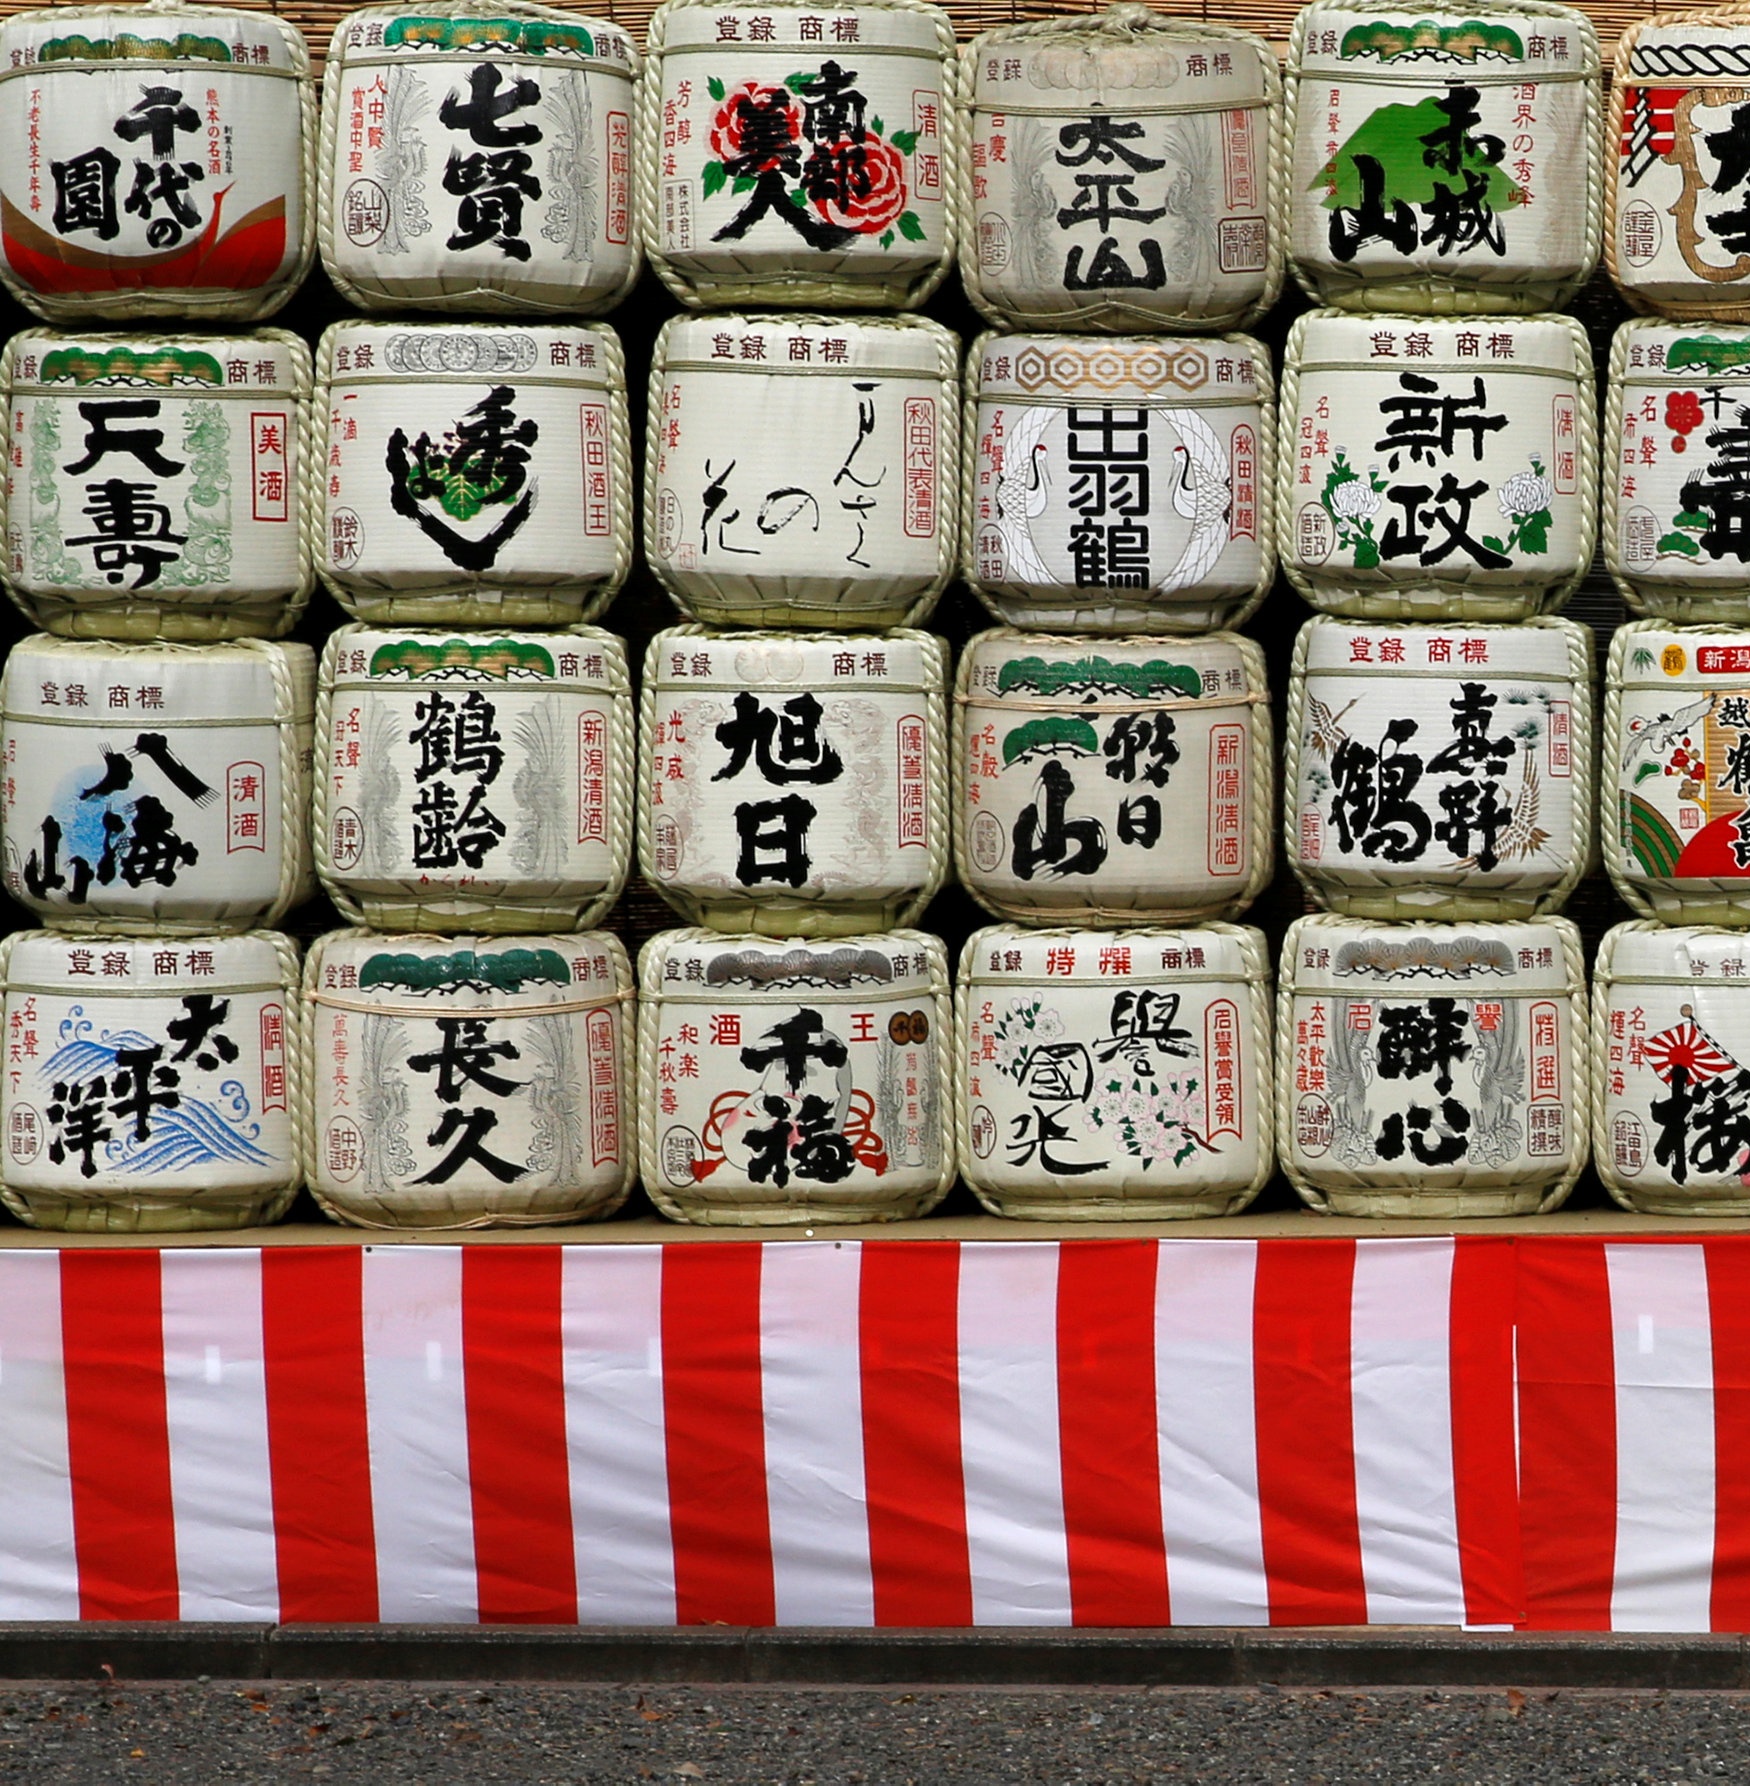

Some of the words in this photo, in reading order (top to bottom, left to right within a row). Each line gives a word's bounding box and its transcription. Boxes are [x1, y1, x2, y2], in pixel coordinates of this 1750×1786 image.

[232, 43, 270, 64] 商標
[716, 15, 776, 42] 登録
[798, 16, 861, 42] 商標
[987, 59, 1022, 81] 登録
[1186, 54, 1233, 77] 商標
[1528, 36, 1568, 60] 商標
[114, 83, 204, 249] 千代の
[206, 88, 221, 175] 熊本の名酒
[439, 62, 543, 262] 七賢
[710, 88, 862, 251] 美人
[799, 60, 871, 214] 南部
[918, 104, 939, 188] 清酒
[48, 147, 120, 240] 園
[1055, 102, 1167, 291] 太平山
[1329, 154, 1418, 262] 山
[227, 359, 276, 384] 商標
[550, 341, 596, 368] 商標
[712, 333, 766, 360] 登録
[788, 337, 849, 363] 商標
[1370, 331, 1433, 357] 登録
[1456, 331, 1515, 359] 商標
[259, 425, 282, 501] 美酒
[585, 411, 606, 529] 秋田酒王
[1068, 404, 1149, 590] 出羽鶴
[1375, 372, 1513, 569] 新政
[671, 652, 712, 677] 登録
[832, 652, 888, 677] 商標
[1350, 636, 1406, 663] 登録
[1427, 638, 1489, 663] 商標
[41, 682, 88, 707] 登録
[108, 685, 164, 709] 商標
[346, 708, 360, 769] 名聲
[79, 733, 221, 888] 八海
[233, 775, 259, 837] 清酒
[710, 691, 844, 888] 旭日
[1012, 759, 1107, 881] 山
[1217, 735, 1238, 865] 新潟清酒
[24, 815, 95, 905] 山
[68, 949, 130, 977] 登録
[153, 951, 215, 976] 商標
[990, 951, 1022, 972] 登録
[1161, 948, 1206, 969] 商標
[1304, 948, 1330, 969] 登録
[1518, 948, 1553, 969] 商標
[709, 1015, 741, 1046] 酒
[850, 1013, 878, 1042] 王
[403, 1018, 533, 1185] 長久
[740, 1003, 856, 1189] 千福
